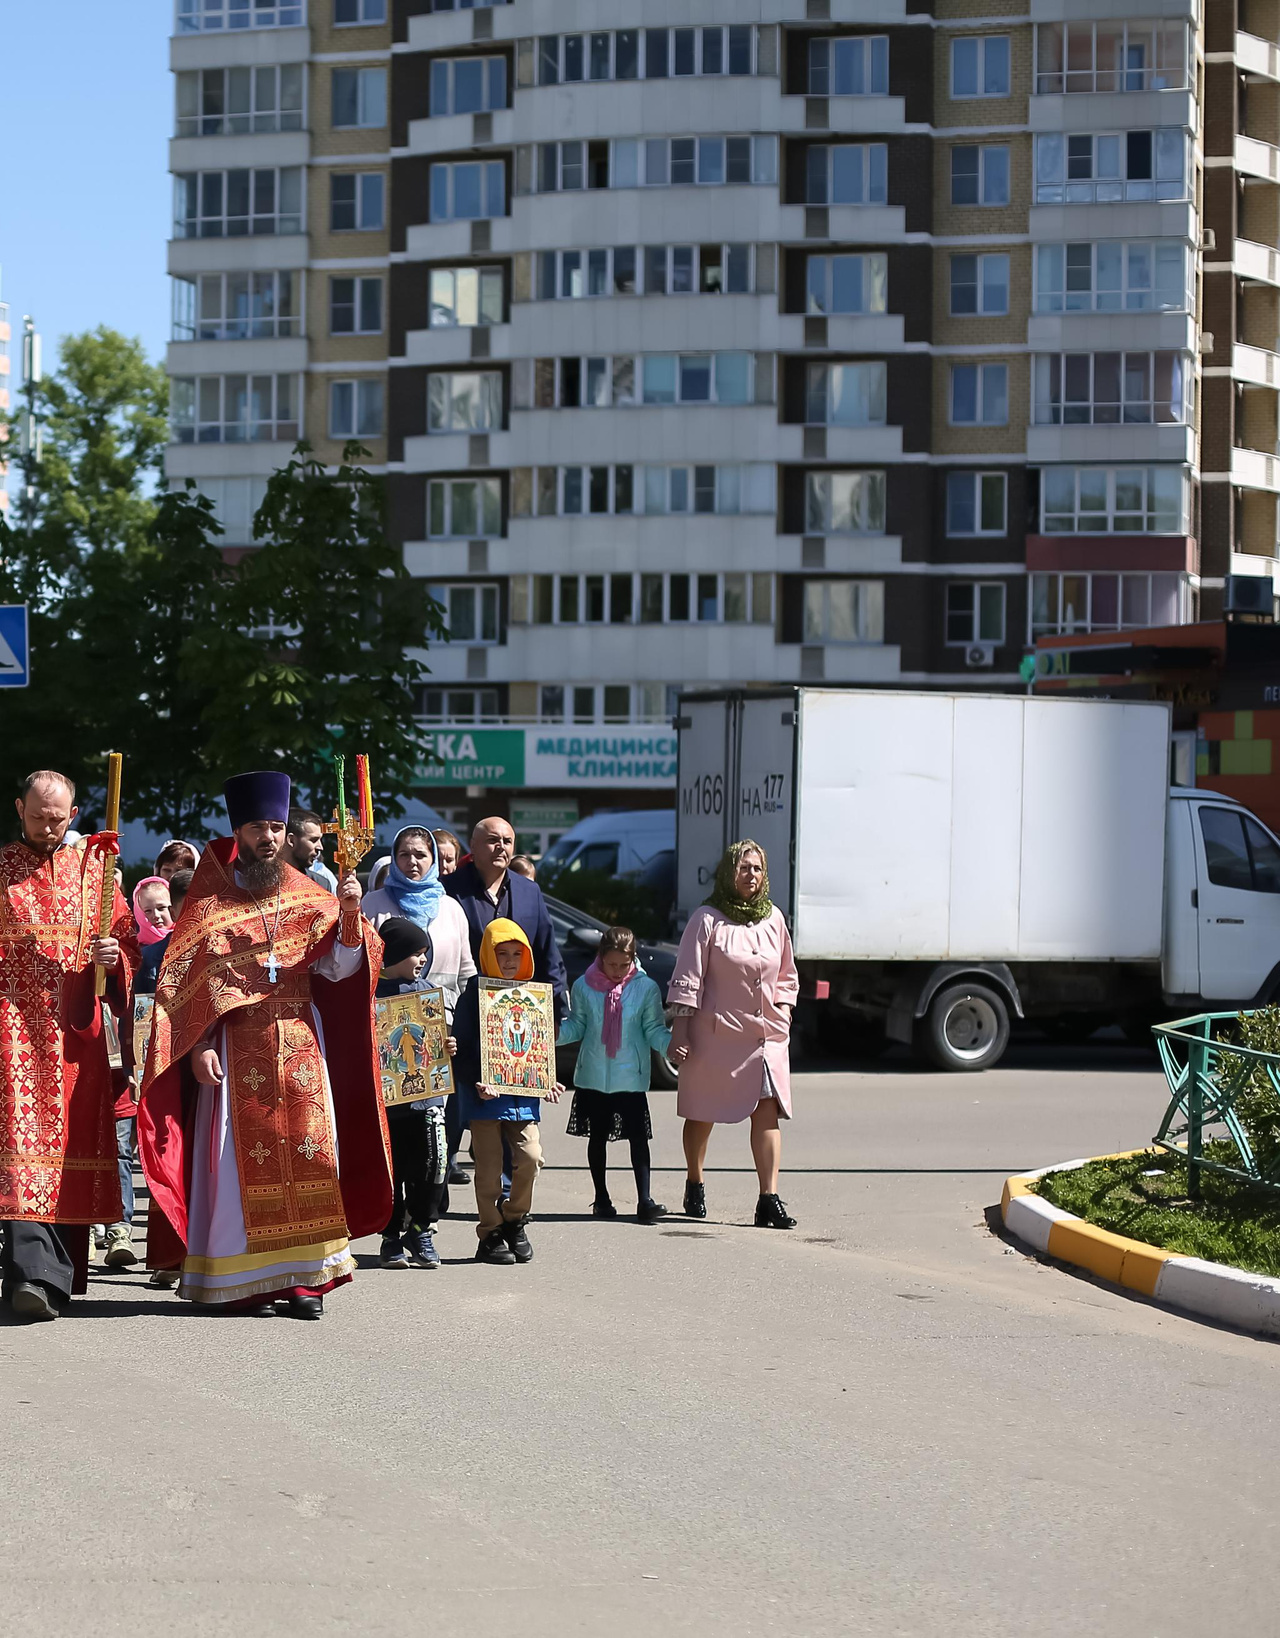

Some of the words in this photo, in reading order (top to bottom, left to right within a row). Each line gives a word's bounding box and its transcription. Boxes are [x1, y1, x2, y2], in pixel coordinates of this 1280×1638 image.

[452, 765, 505, 780] ЦЕНТР
[568, 760, 678, 777] КЛИНИКА
[764, 774, 784, 799] 177
[764, 801, 776, 812] RUS
